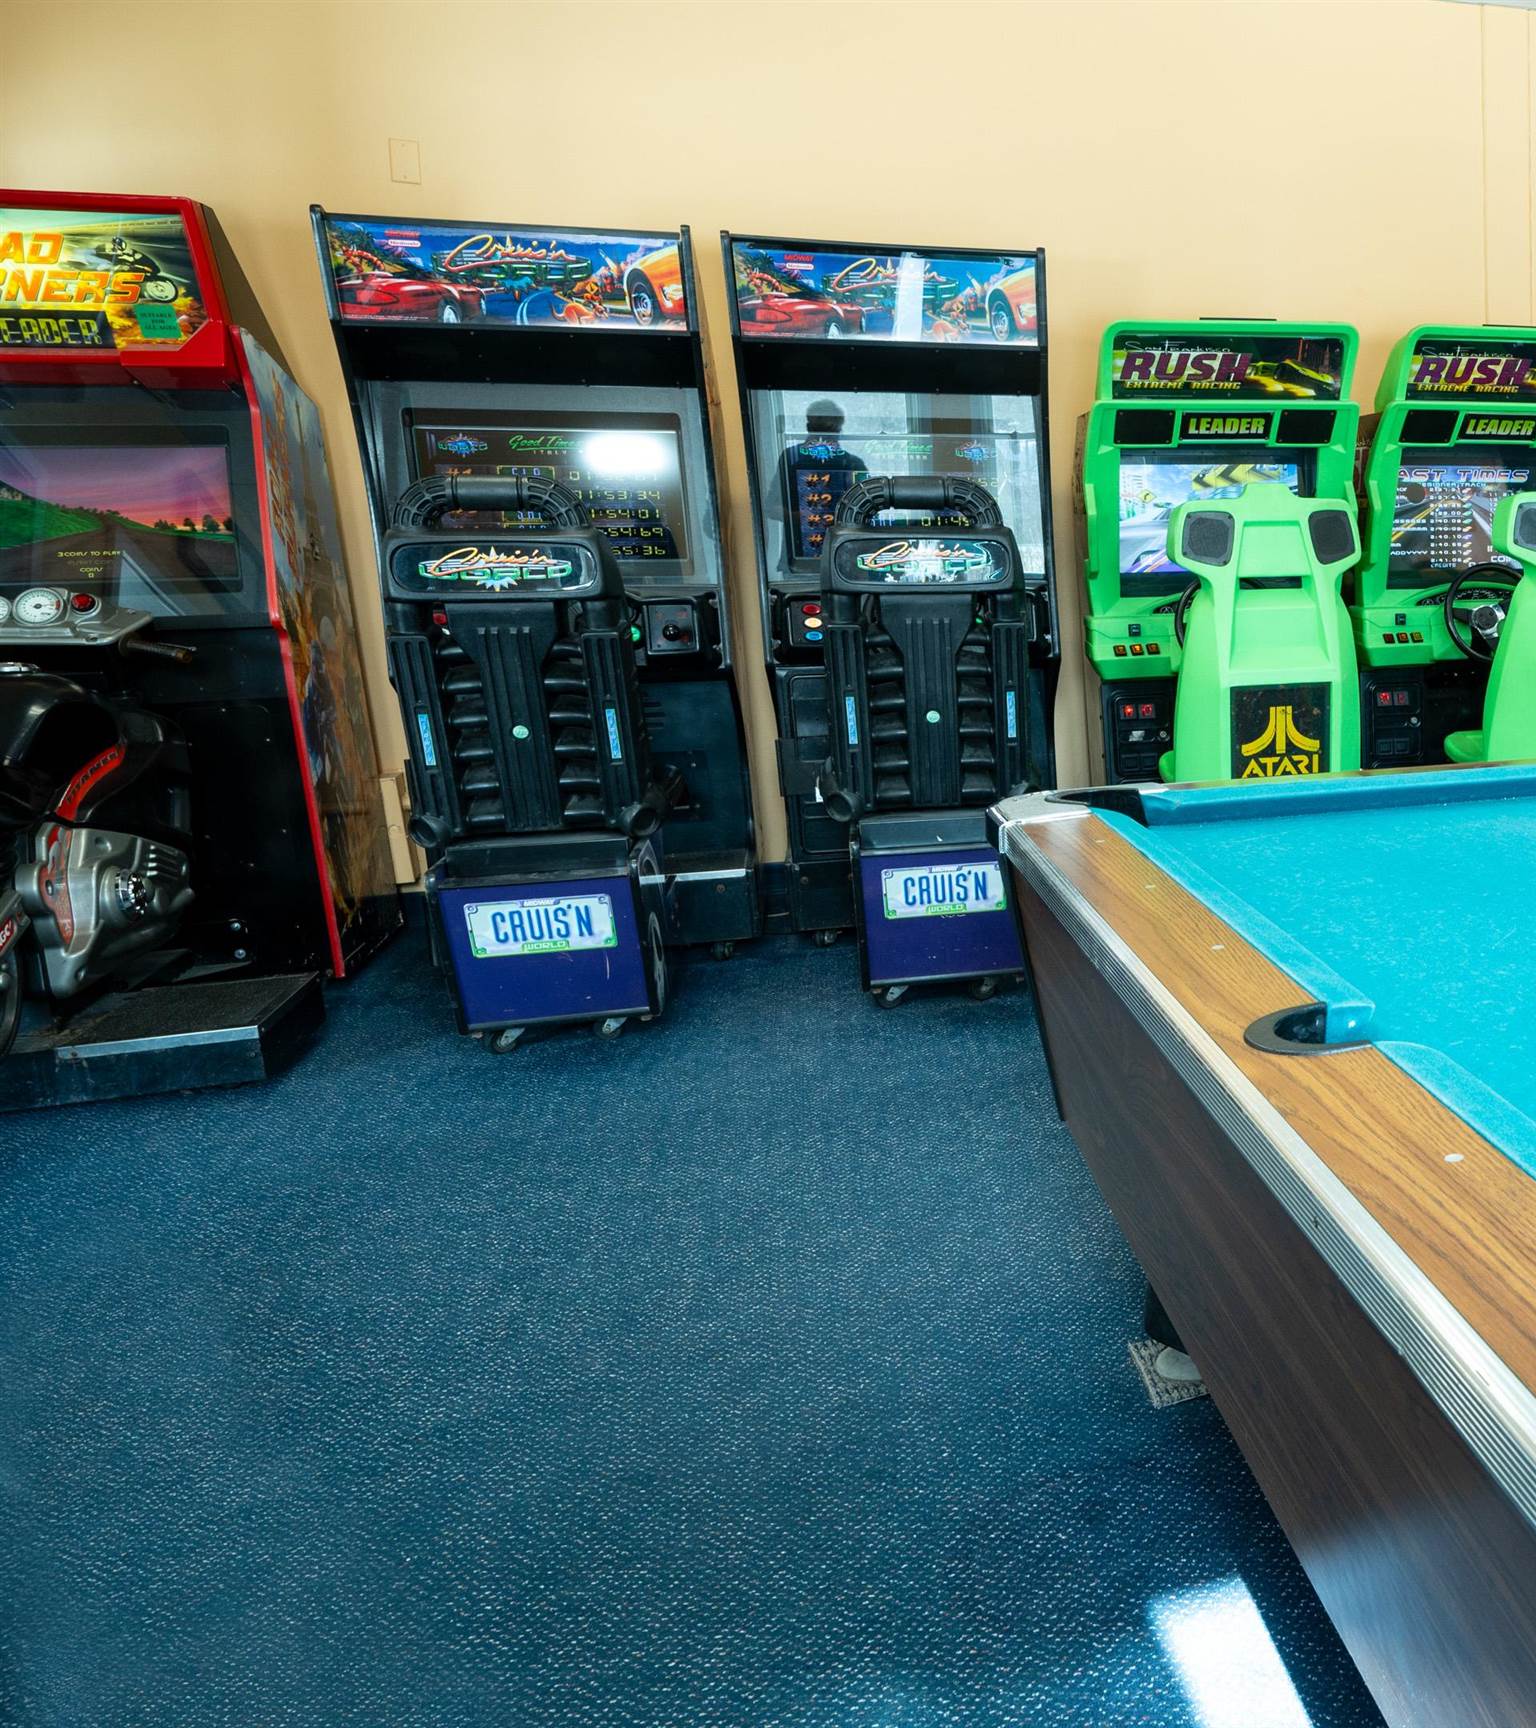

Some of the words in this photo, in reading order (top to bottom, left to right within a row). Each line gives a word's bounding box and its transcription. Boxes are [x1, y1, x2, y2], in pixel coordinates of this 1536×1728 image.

[0, 317, 103, 344] EADER
[1120, 351, 1253, 381] RUSH
[1413, 356, 1533, 385] RUSH
[1125, 381, 1184, 389] EXTREME
[1190, 382, 1241, 390] RACING
[1416, 384, 1470, 392] EXTREME
[1475, 385, 1519, 393] RACING
[1188, 417, 1265, 435] LEADER
[1465, 418, 1536, 436] LEADER
[1398, 469, 1447, 483] AST
[1456, 469, 1530, 483] TIMES
[1241, 754, 1320, 780] ATARI
[903, 870, 988, 906] CRUIS'N
[927, 905, 964, 913] WORLD
[491, 904, 594, 943] CRUIS'N
[524, 941, 567, 950] WORLD
